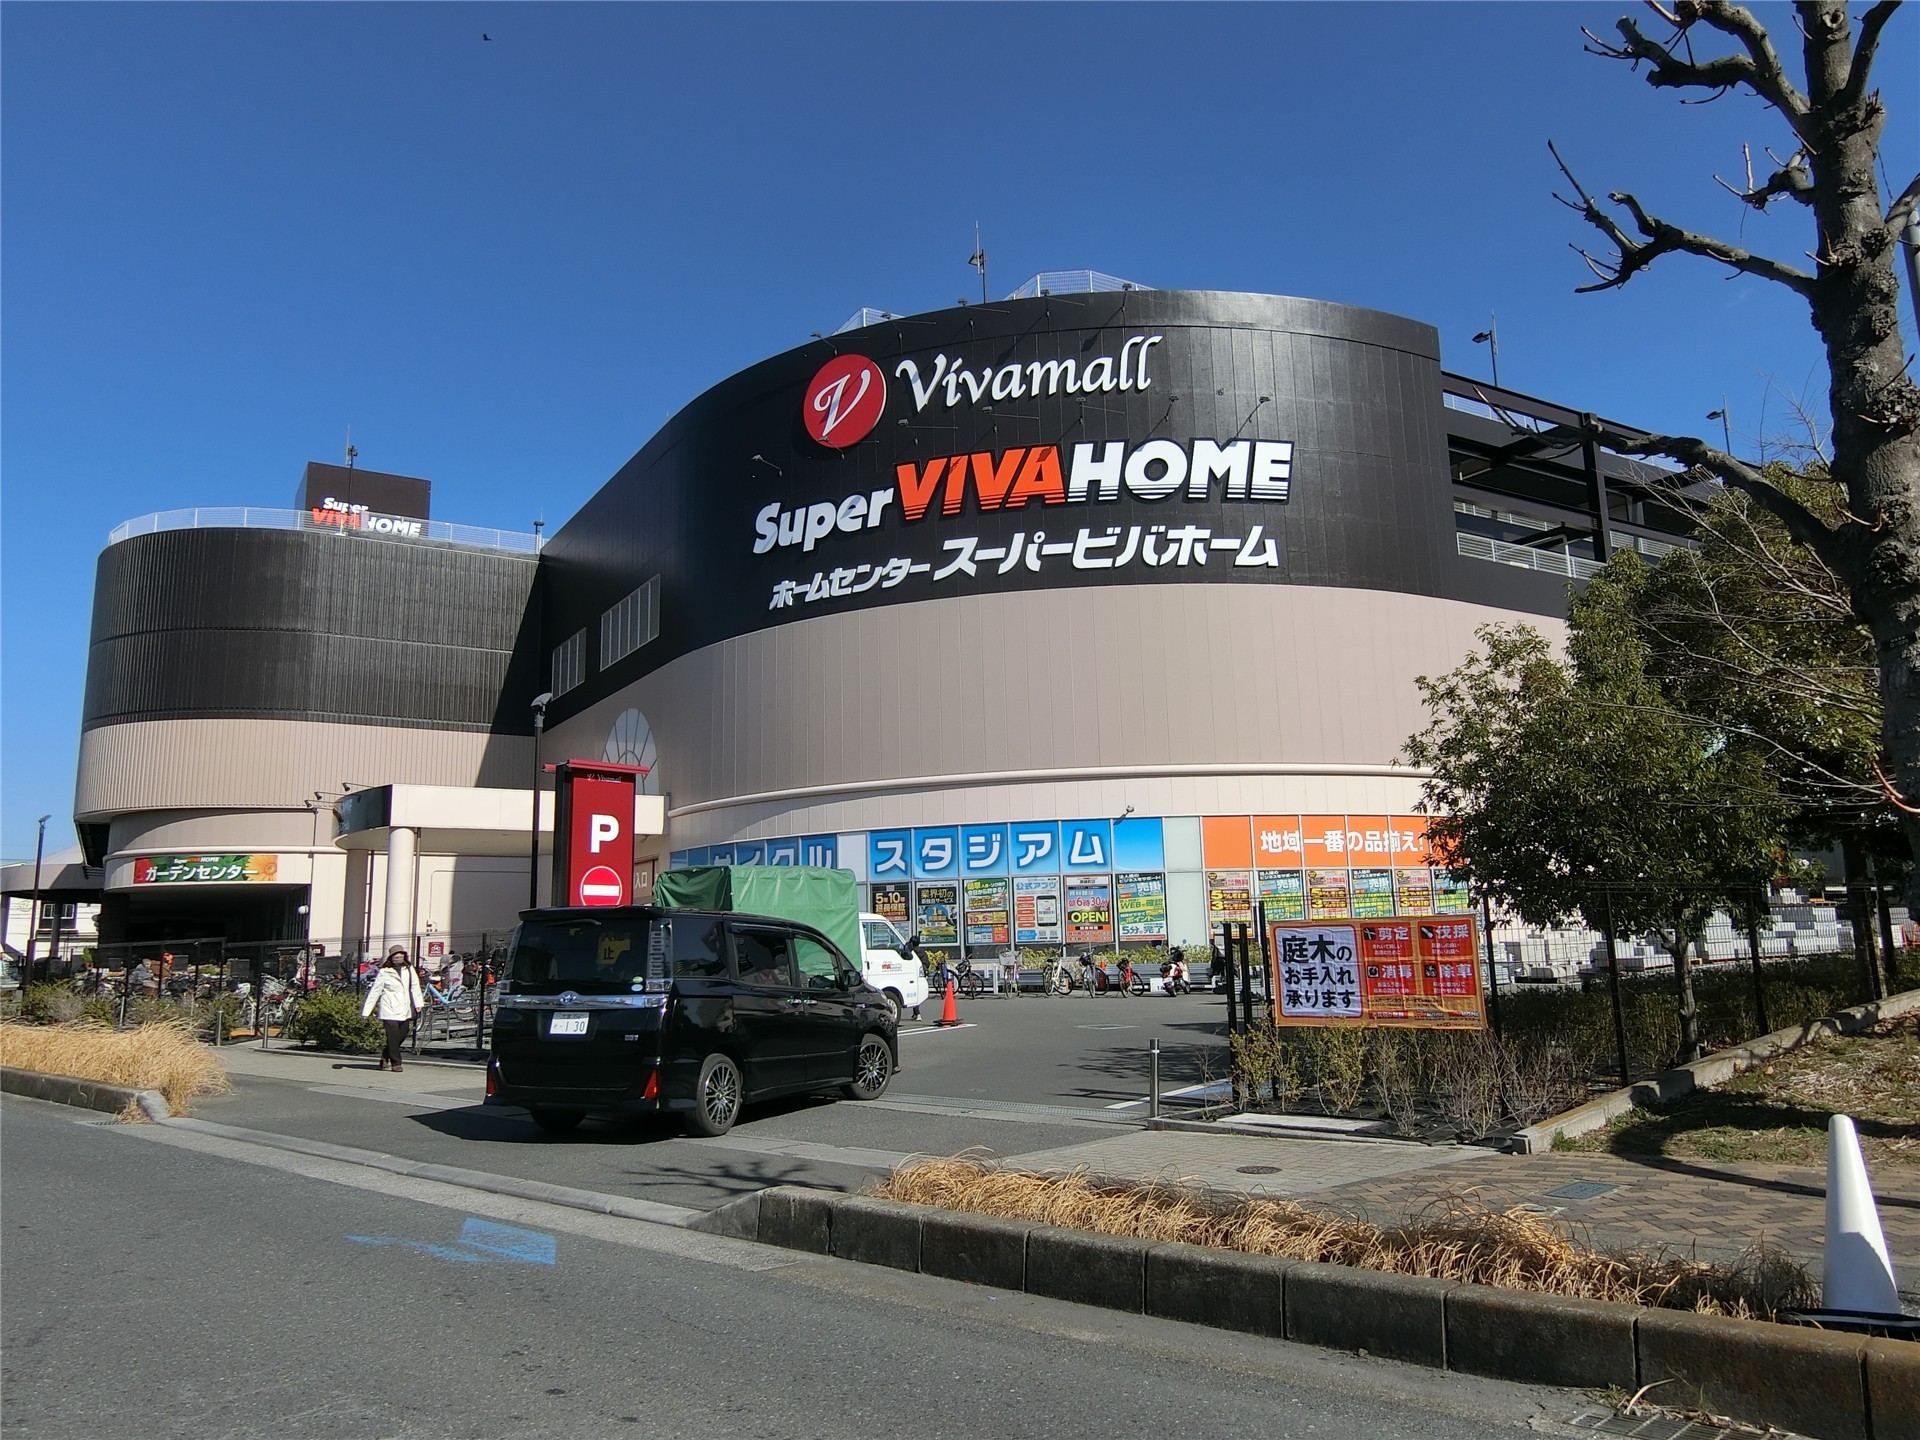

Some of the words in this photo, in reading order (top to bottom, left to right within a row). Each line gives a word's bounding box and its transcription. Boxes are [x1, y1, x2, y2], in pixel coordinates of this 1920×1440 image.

[896, 335, 1164, 413] Vivamall
[752, 487, 894, 555] Super
[768, 556, 932, 611] ホームセンター
[932, 524, 1280, 582] スーパービバホーム
[590, 814, 620, 854] P
[876, 831, 1105, 873] スタジアム
[146, 864, 258, 882] ガーデンセンター
[633, 871, 648, 889] 入口
[1071, 911, 1109, 923] OPEN!
[1377, 926, 1409, 941] 剪定
[1436, 924, 1469, 939] 伐採
[1282, 934, 1352, 964] 庭木の
[1284, 966, 1355, 986] お手入れ
[1381, 964, 1412, 979] 消毒
[1439, 963, 1473, 979] 除草
[1285, 989, 1356, 1008] 承ります
